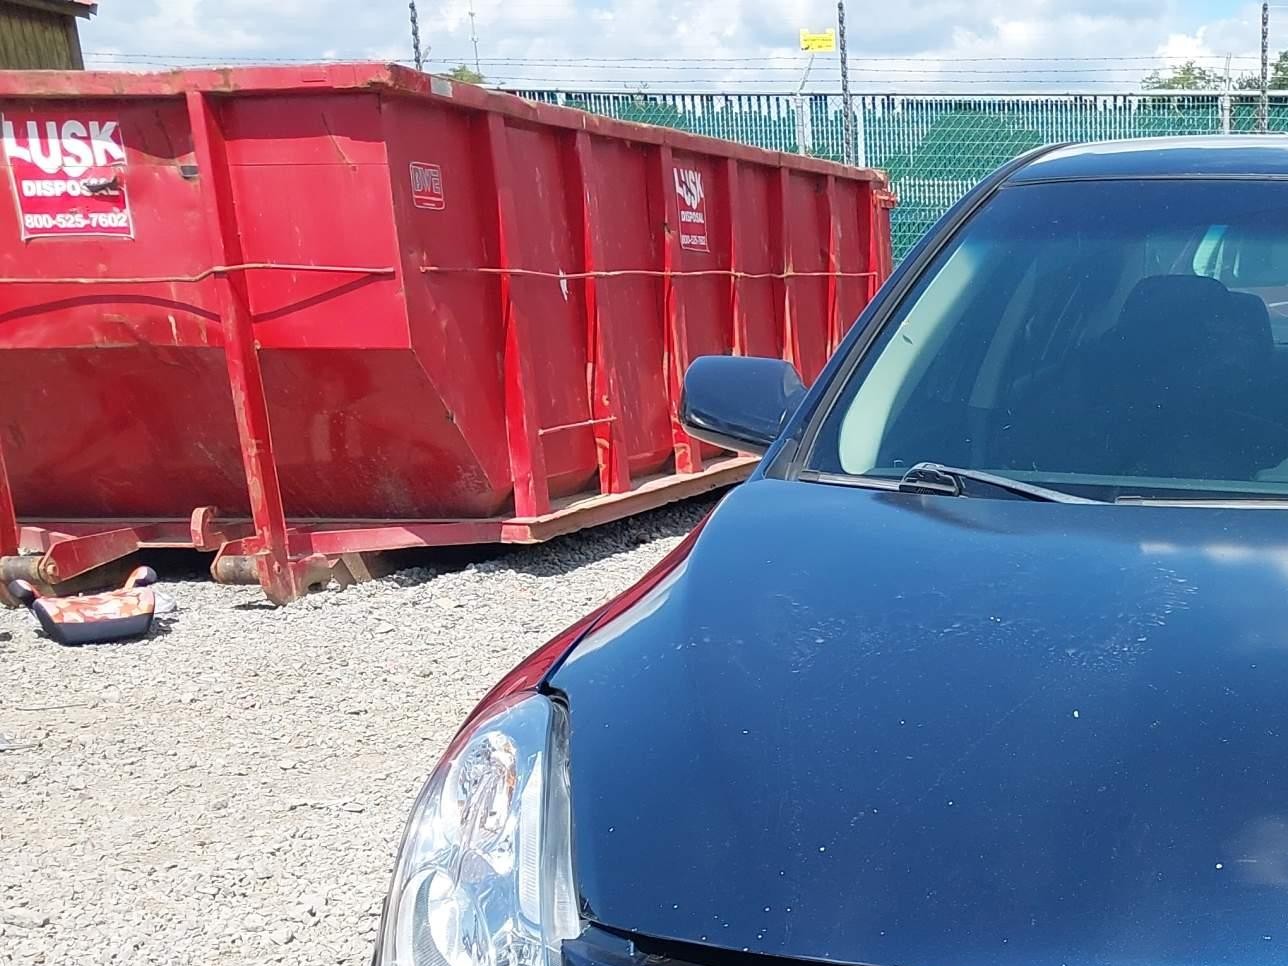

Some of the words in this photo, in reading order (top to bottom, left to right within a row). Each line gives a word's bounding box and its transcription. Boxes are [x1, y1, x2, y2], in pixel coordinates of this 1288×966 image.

[2, 120, 125, 177] LUSK
[673, 168, 704, 210] LUSK
[24, 212, 129, 229] 800-525-7602
